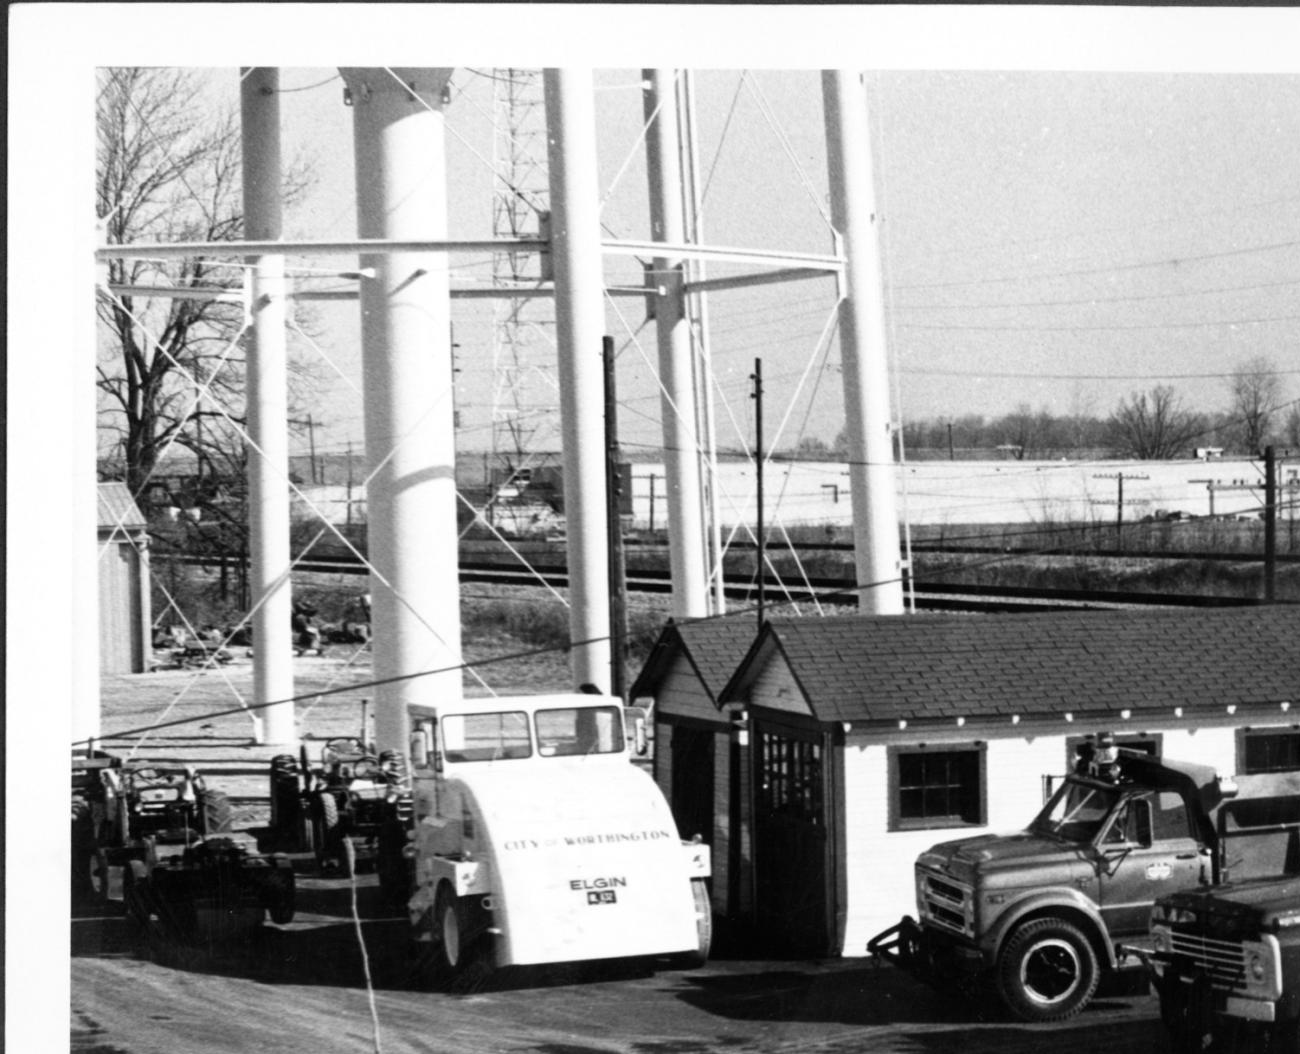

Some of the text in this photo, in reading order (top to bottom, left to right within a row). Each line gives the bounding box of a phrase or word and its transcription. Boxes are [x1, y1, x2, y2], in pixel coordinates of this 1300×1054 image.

[503, 839, 539, 851] CITY
[564, 830, 670, 846] WORTHINGTON
[569, 876, 627, 890] ELGIN
